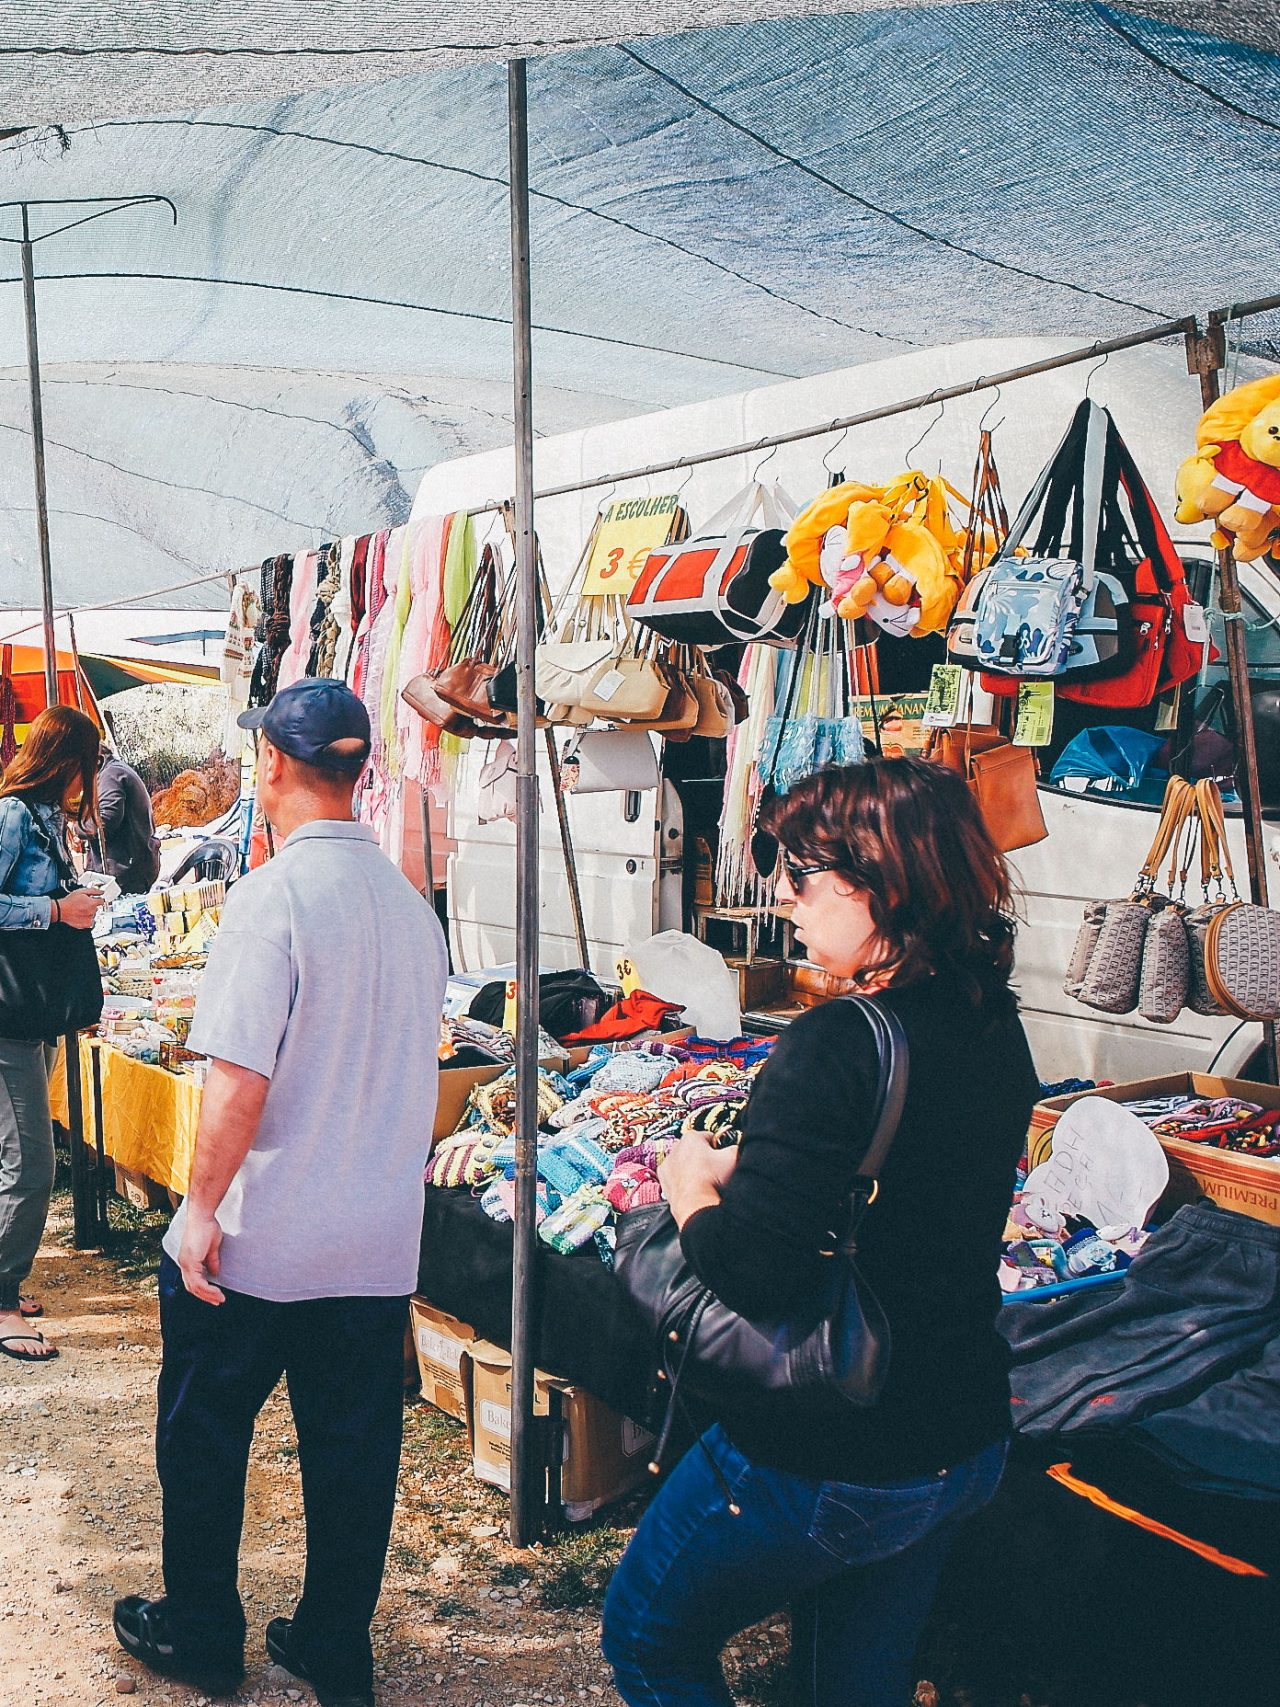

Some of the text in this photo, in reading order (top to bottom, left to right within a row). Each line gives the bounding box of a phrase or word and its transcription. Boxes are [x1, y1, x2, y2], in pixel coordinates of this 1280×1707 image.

[603, 505, 614, 523] A
[600, 548, 624, 579] 3
[1202, 1180, 1277, 1211] PREMIUM
